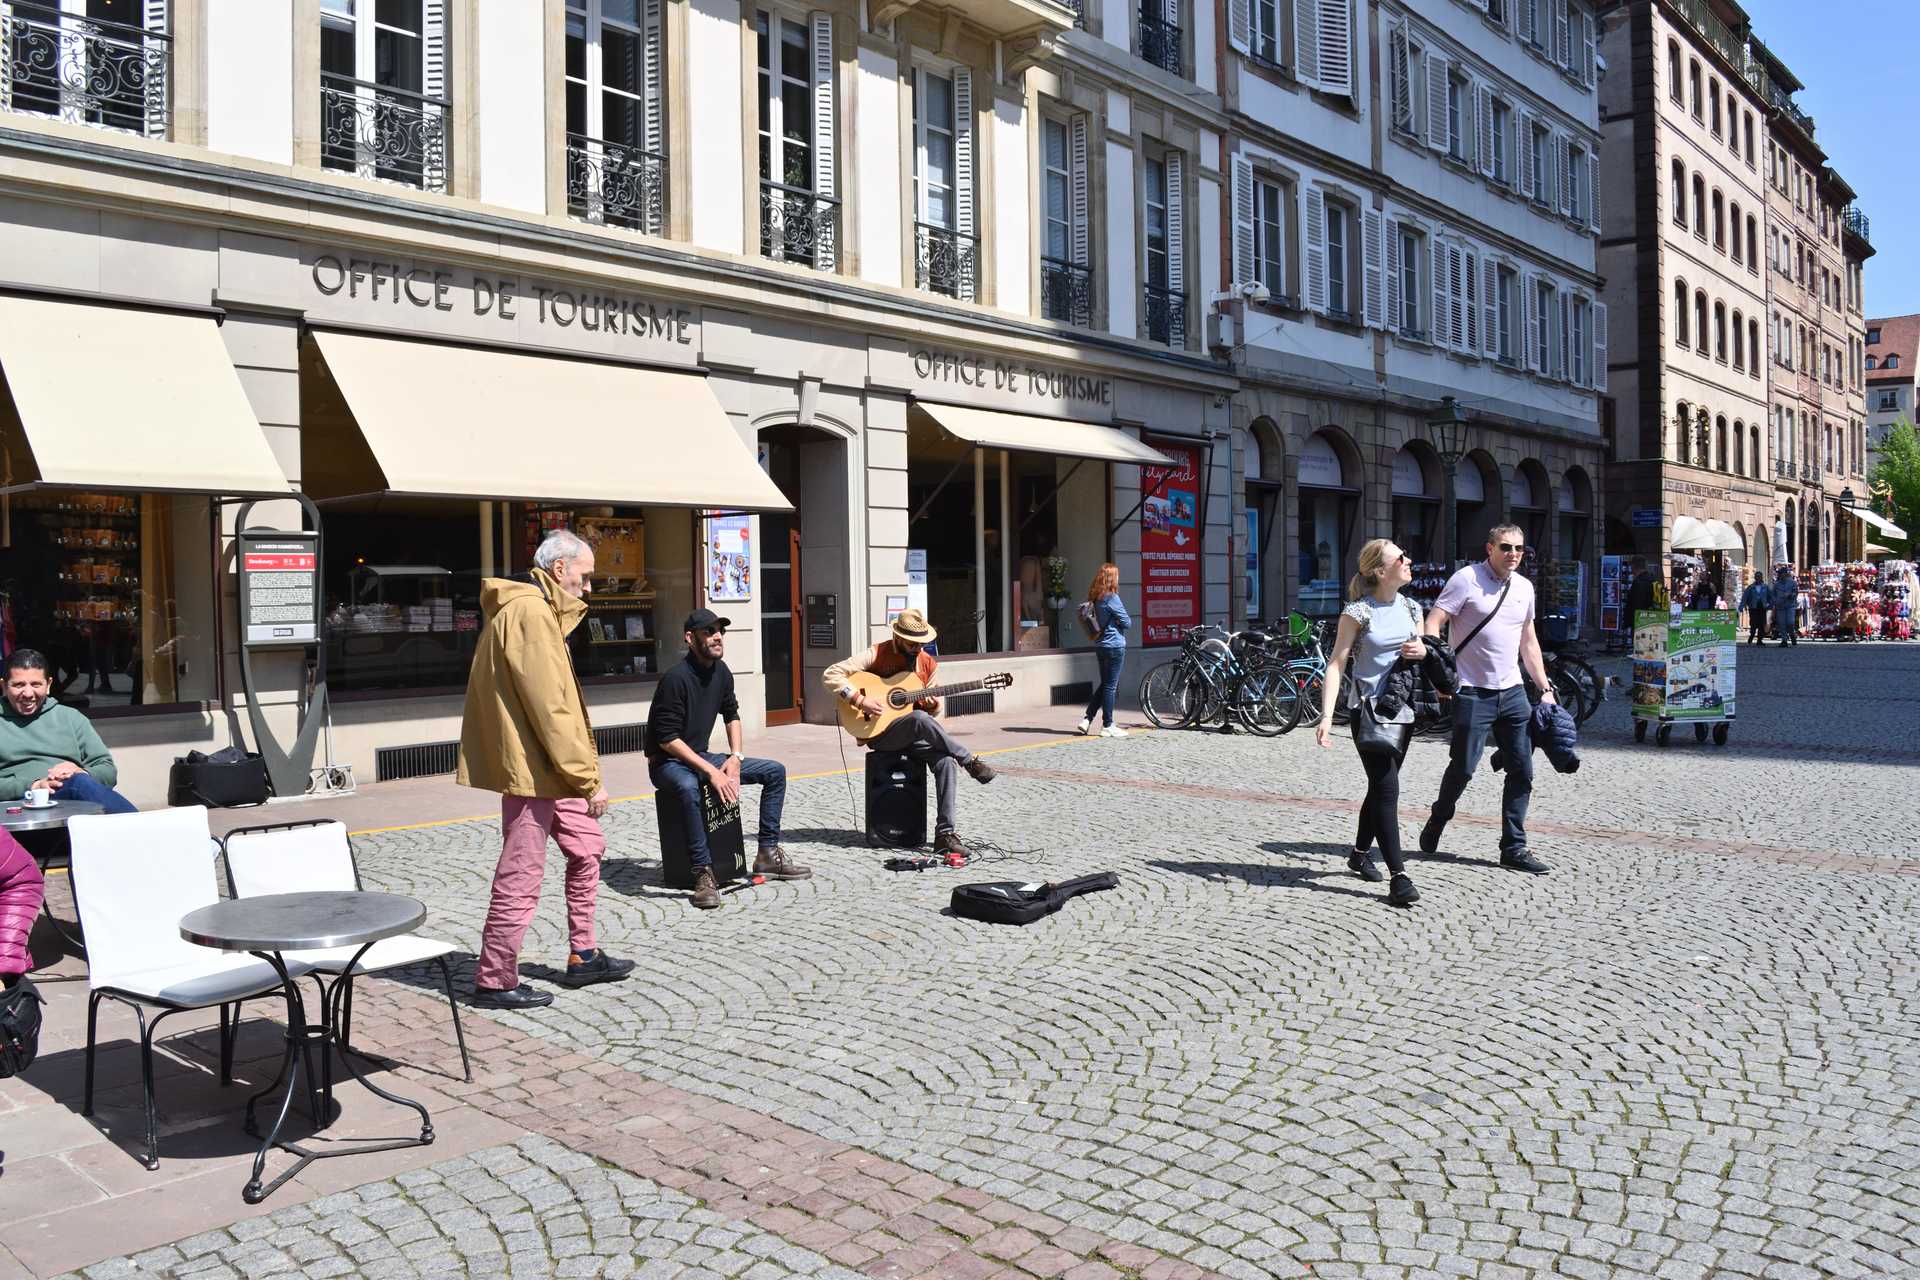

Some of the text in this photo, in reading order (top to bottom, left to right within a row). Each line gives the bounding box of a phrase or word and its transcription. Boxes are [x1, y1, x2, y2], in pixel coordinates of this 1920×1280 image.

[312, 255, 692, 345] OFFICE DE TOURISME
[914, 350, 1112, 405] OFFICE DE TOURISME
